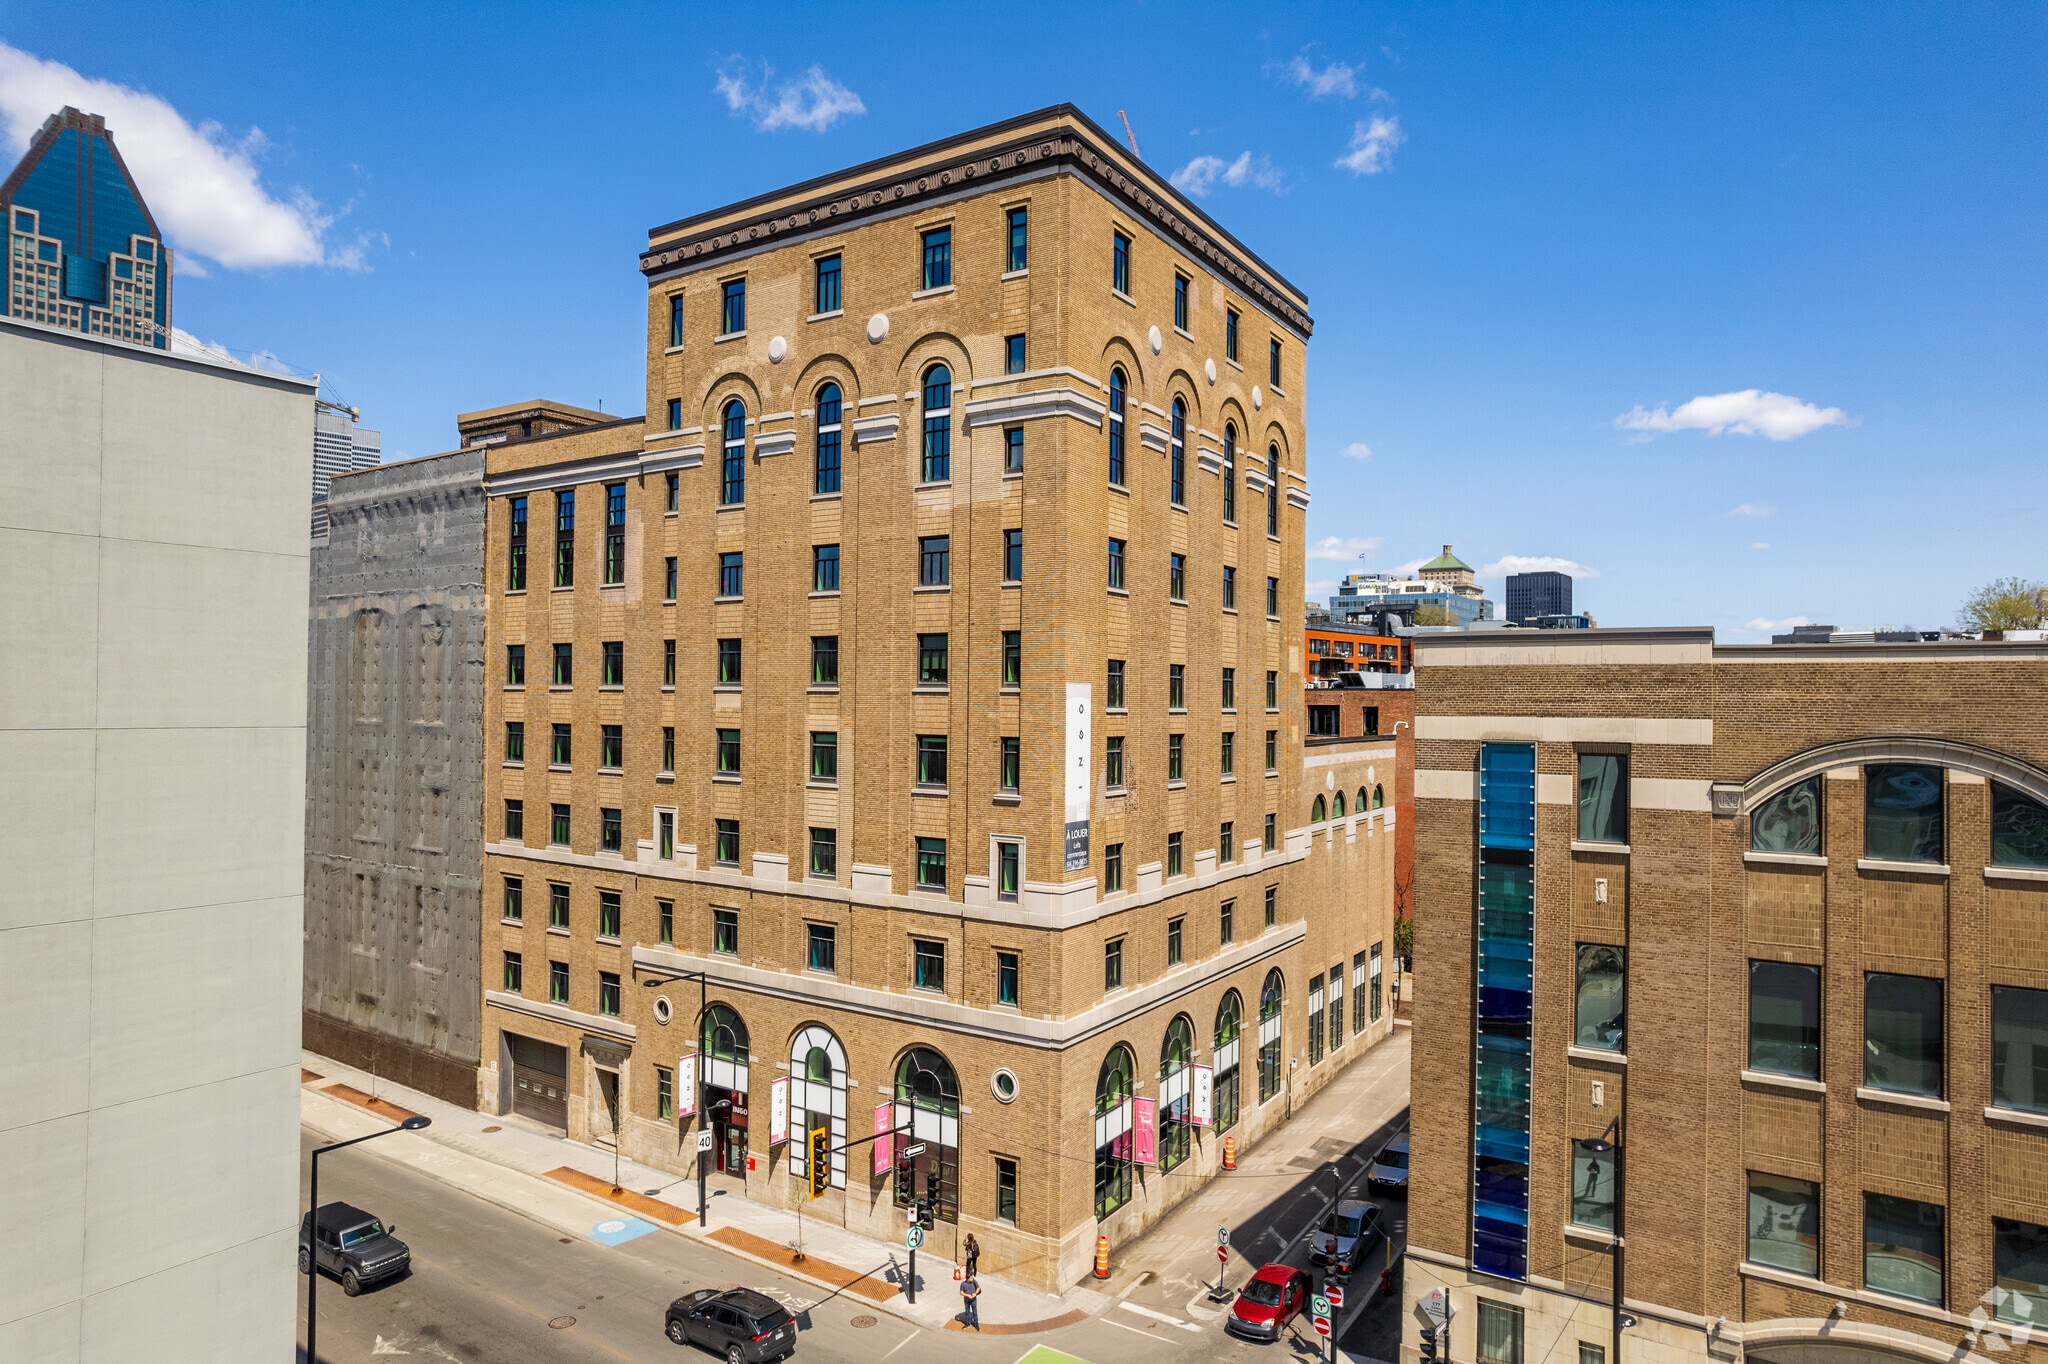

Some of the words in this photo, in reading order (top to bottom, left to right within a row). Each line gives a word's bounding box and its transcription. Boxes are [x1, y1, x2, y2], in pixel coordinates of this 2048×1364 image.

[1071, 828, 1088, 839] LOUER
[732, 1106, 748, 1116] INGO
[699, 1136, 710, 1148] 40
